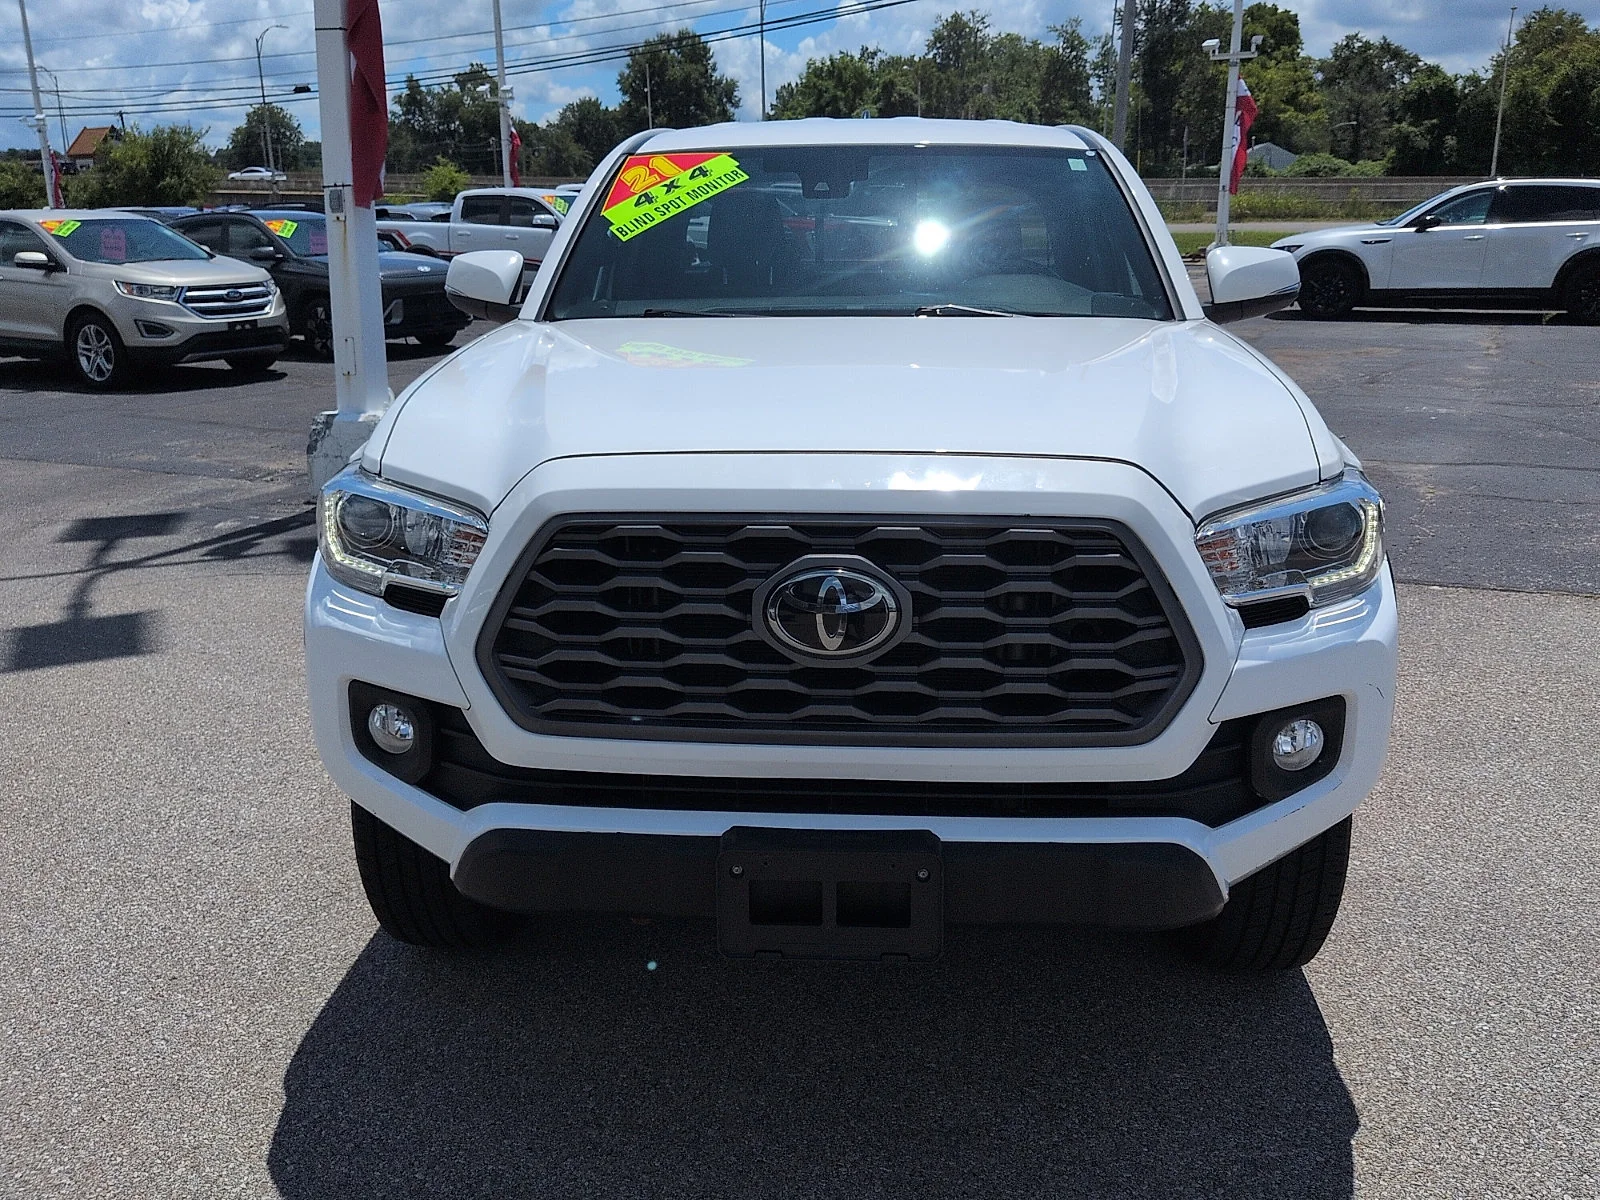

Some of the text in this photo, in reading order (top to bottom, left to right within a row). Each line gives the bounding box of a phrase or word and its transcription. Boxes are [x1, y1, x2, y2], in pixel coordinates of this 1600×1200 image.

[620, 156, 684, 193] 21
[633, 191, 658, 208] 4
[688, 165, 713, 181] 4
[616, 169, 744, 237] BLIND SPOT MONITOR
